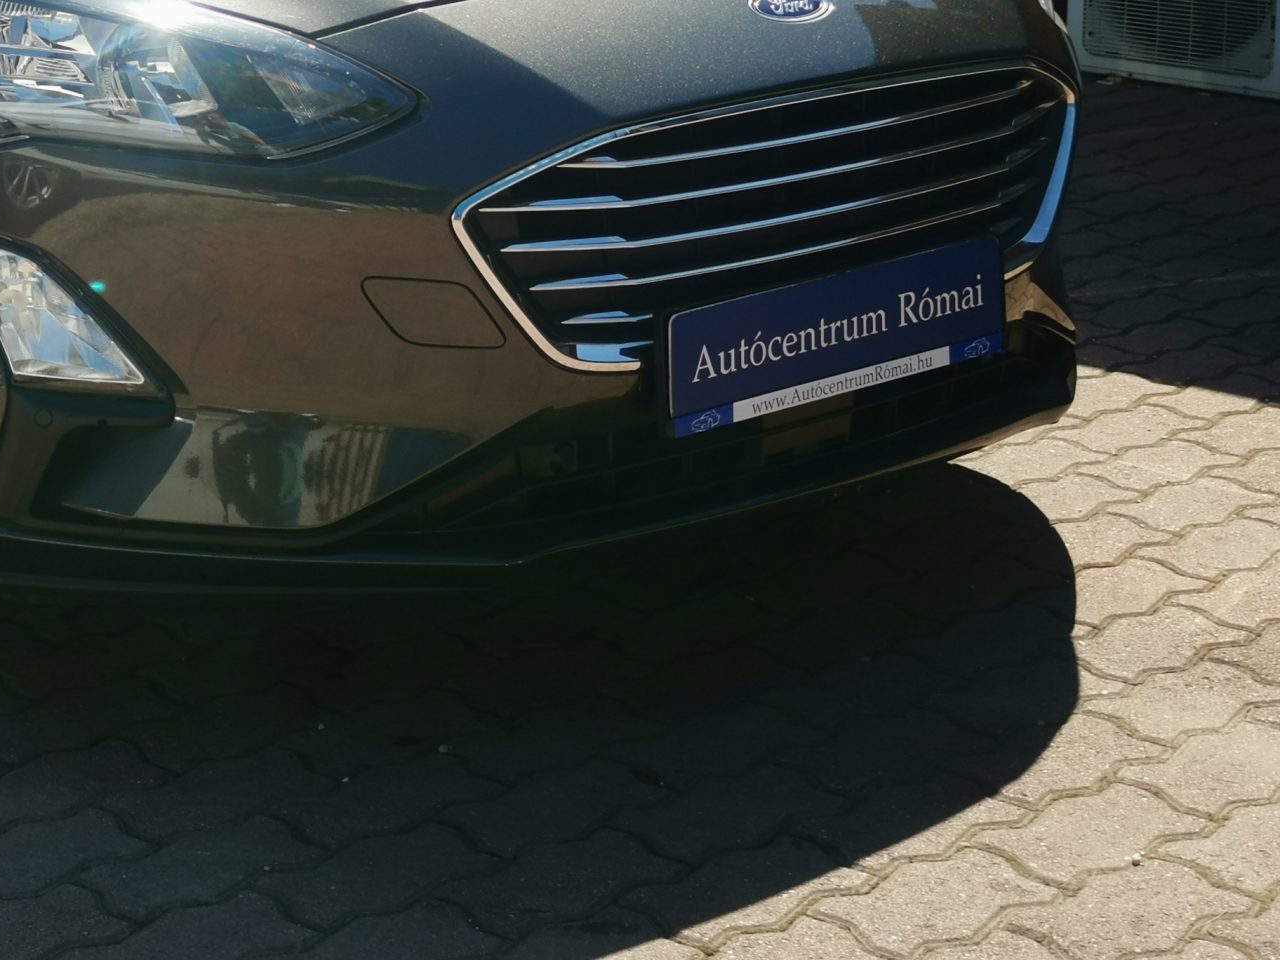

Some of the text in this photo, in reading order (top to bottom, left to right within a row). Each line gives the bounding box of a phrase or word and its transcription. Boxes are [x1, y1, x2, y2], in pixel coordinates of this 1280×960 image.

[691, 274, 984, 383] Autócentrum Római
[752, 352, 933, 416] www.AutócentrumRómai.hu
